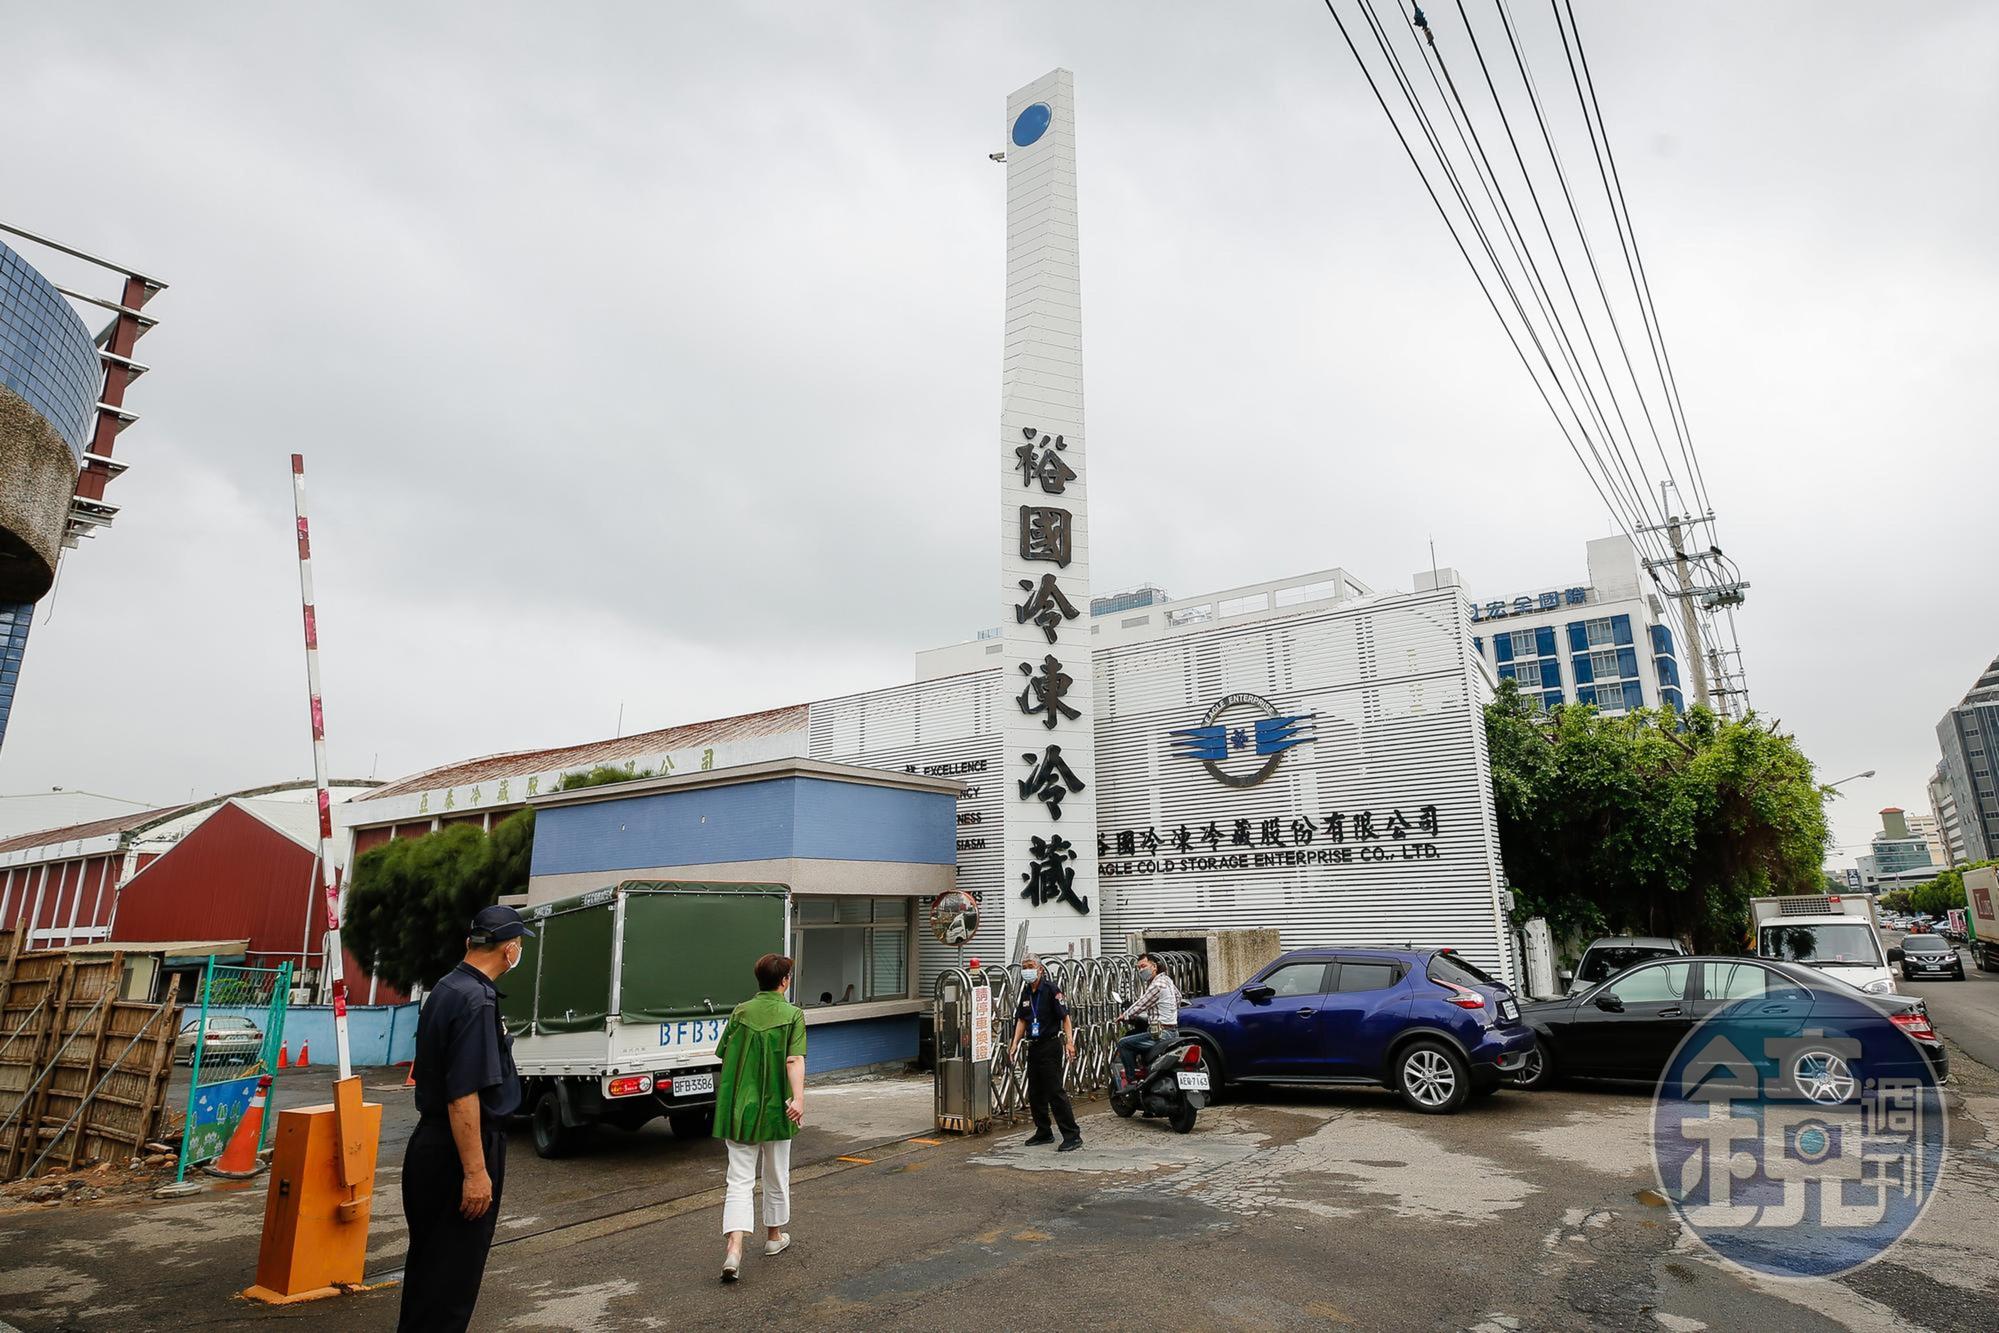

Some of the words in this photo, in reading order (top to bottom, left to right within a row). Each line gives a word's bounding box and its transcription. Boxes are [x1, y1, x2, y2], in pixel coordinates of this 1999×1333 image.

[1486, 587, 1586, 618] 宏全國際
[1014, 427, 1090, 917] 裕國冷凍冷藏
[1204, 700, 1226, 724] EAGLE
[1228, 694, 1275, 715] ENTERPRISE
[923, 760, 987, 776] EXCELLENCE
[1098, 862, 1133, 876] AGLE
[1137, 860, 1175, 873] COLD
[1180, 854, 1249, 871] STORAGE
[1254, 849, 1352, 867] ENTERPRISE
